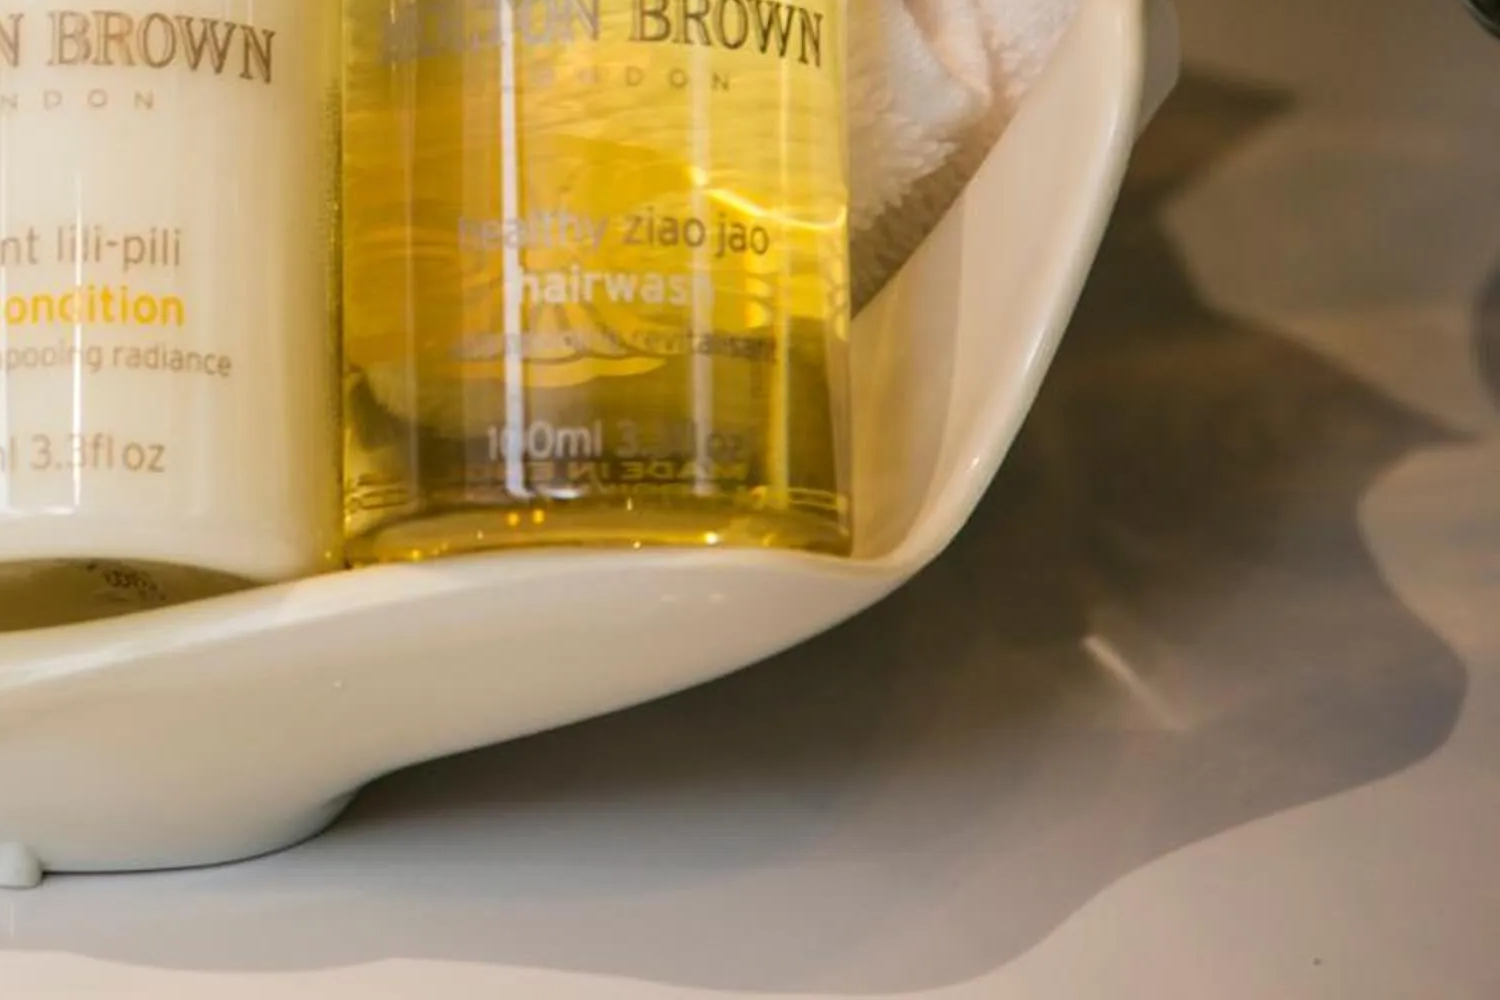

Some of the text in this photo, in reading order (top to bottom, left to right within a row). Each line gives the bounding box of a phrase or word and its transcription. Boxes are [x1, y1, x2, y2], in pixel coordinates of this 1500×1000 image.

[45, 9, 278, 86] BROWN
[56, 224, 184, 274] lili-pili
[622, 206, 707, 250] ziao
[714, 211, 771, 258] jao
[112, 343, 233, 379] radiance
[121, 440, 167, 475] oz
